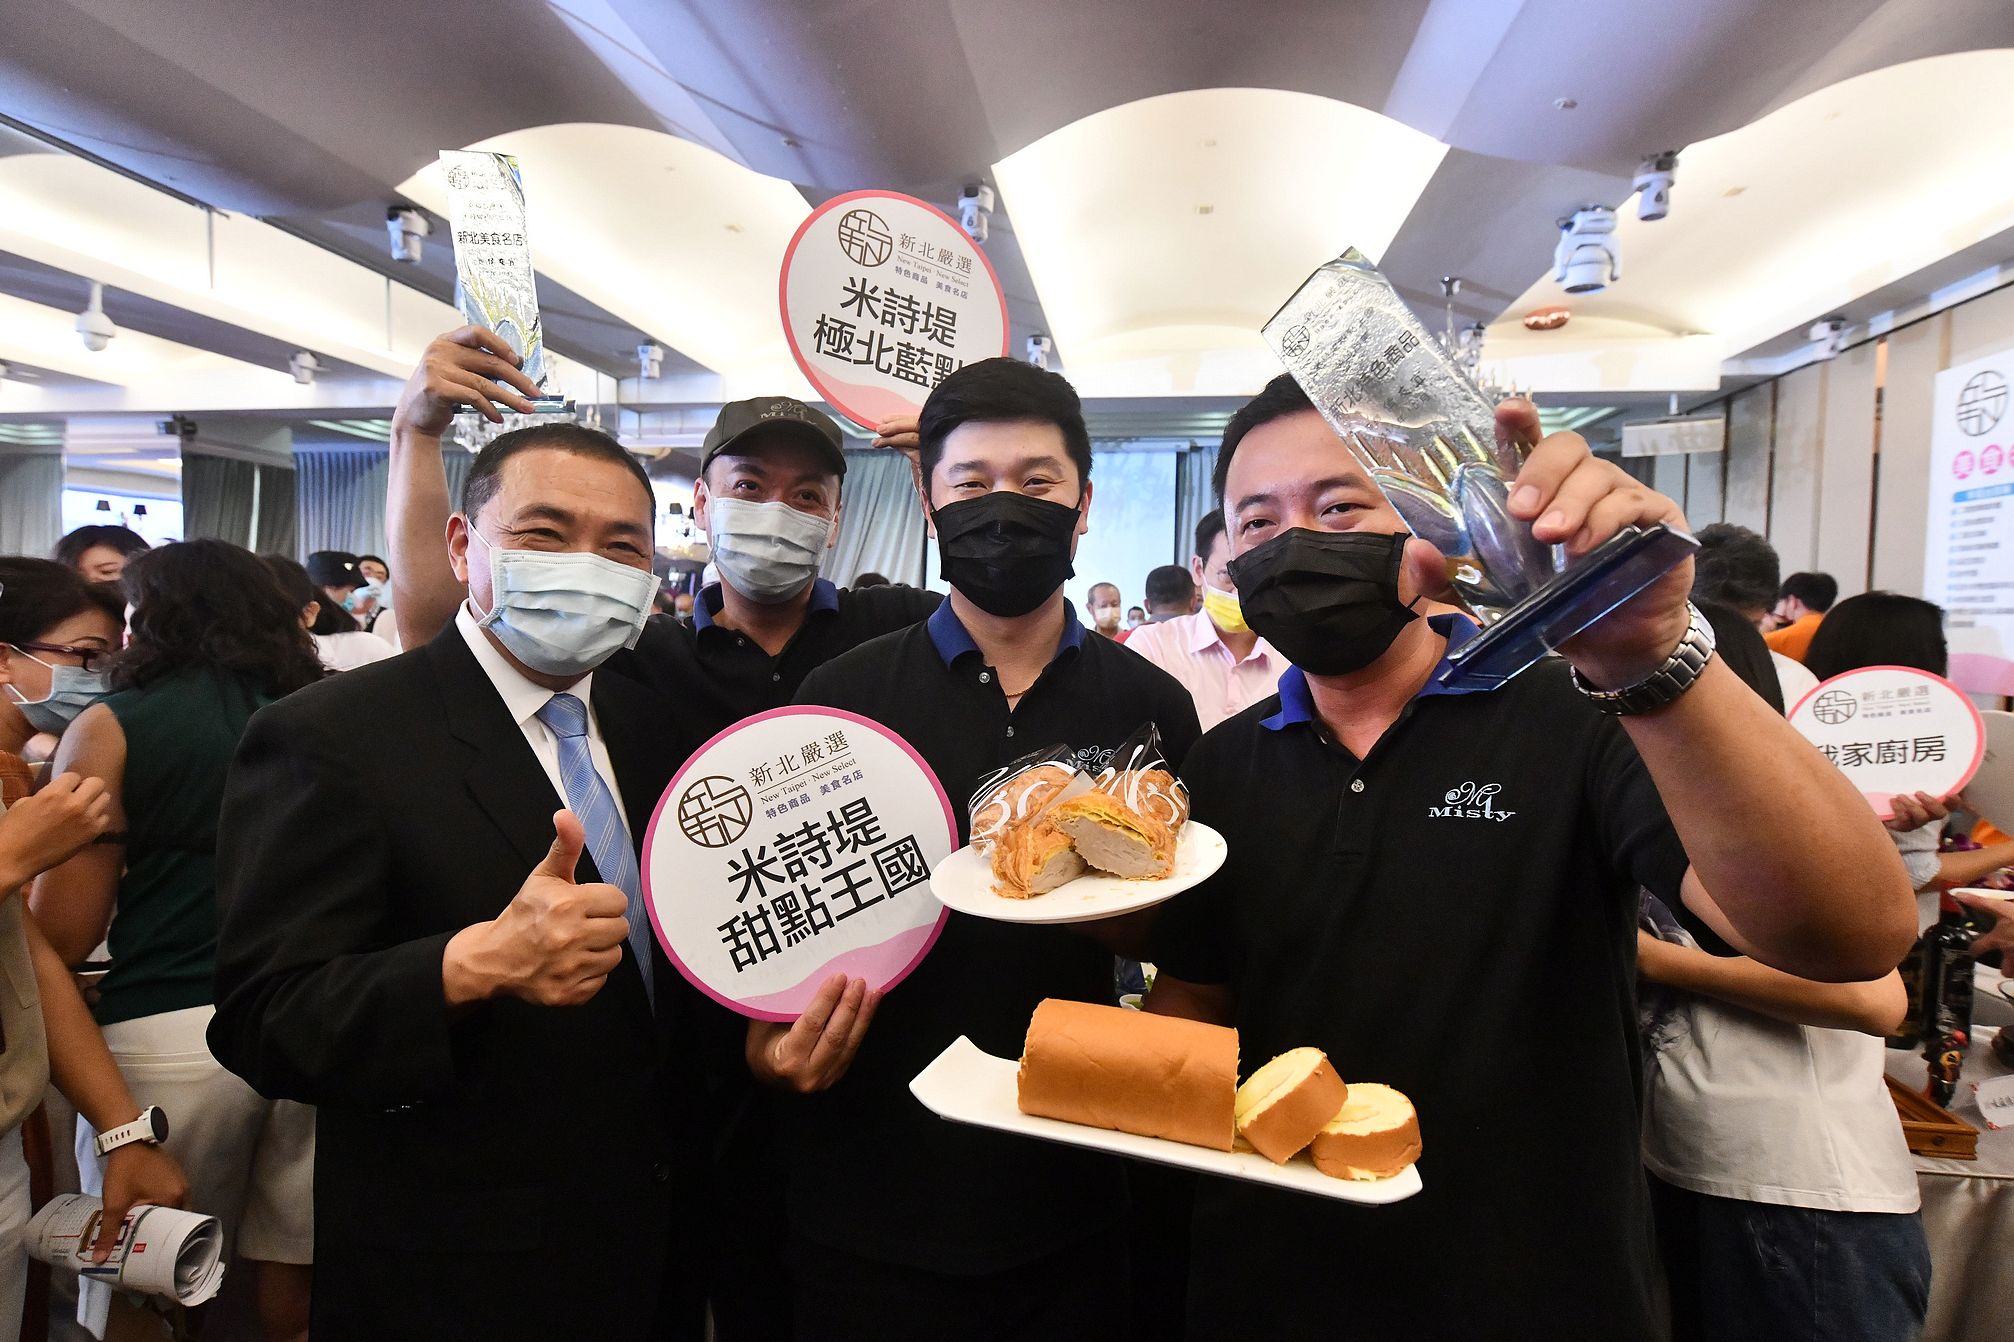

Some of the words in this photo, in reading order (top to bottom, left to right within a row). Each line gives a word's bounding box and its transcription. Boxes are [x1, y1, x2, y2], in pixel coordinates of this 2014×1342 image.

[457, 231, 523, 246] 新北美食名店
[899, 233, 972, 274] 新北嚴選
[897, 255, 911, 265] New
[914, 261, 932, 273] Taipei
[936, 270, 949, 280] New
[951, 276, 969, 287] Select
[935, 281, 969, 299] 美食名店
[839, 276, 958, 348] 米詩堤
[748, 730, 850, 787] 新北嚴選
[760, 792, 780, 805] New
[780, 780, 807, 796] Taipei
[812, 770, 831, 782] New
[831, 758, 857, 772] Select
[765, 793, 811, 819] 特色商品
[819, 769, 864, 796] 美食名店
[1428, 795, 1517, 822] Misty
[727, 796, 887, 903] 米詩堤
[716, 834, 931, 973] 甜點王國
